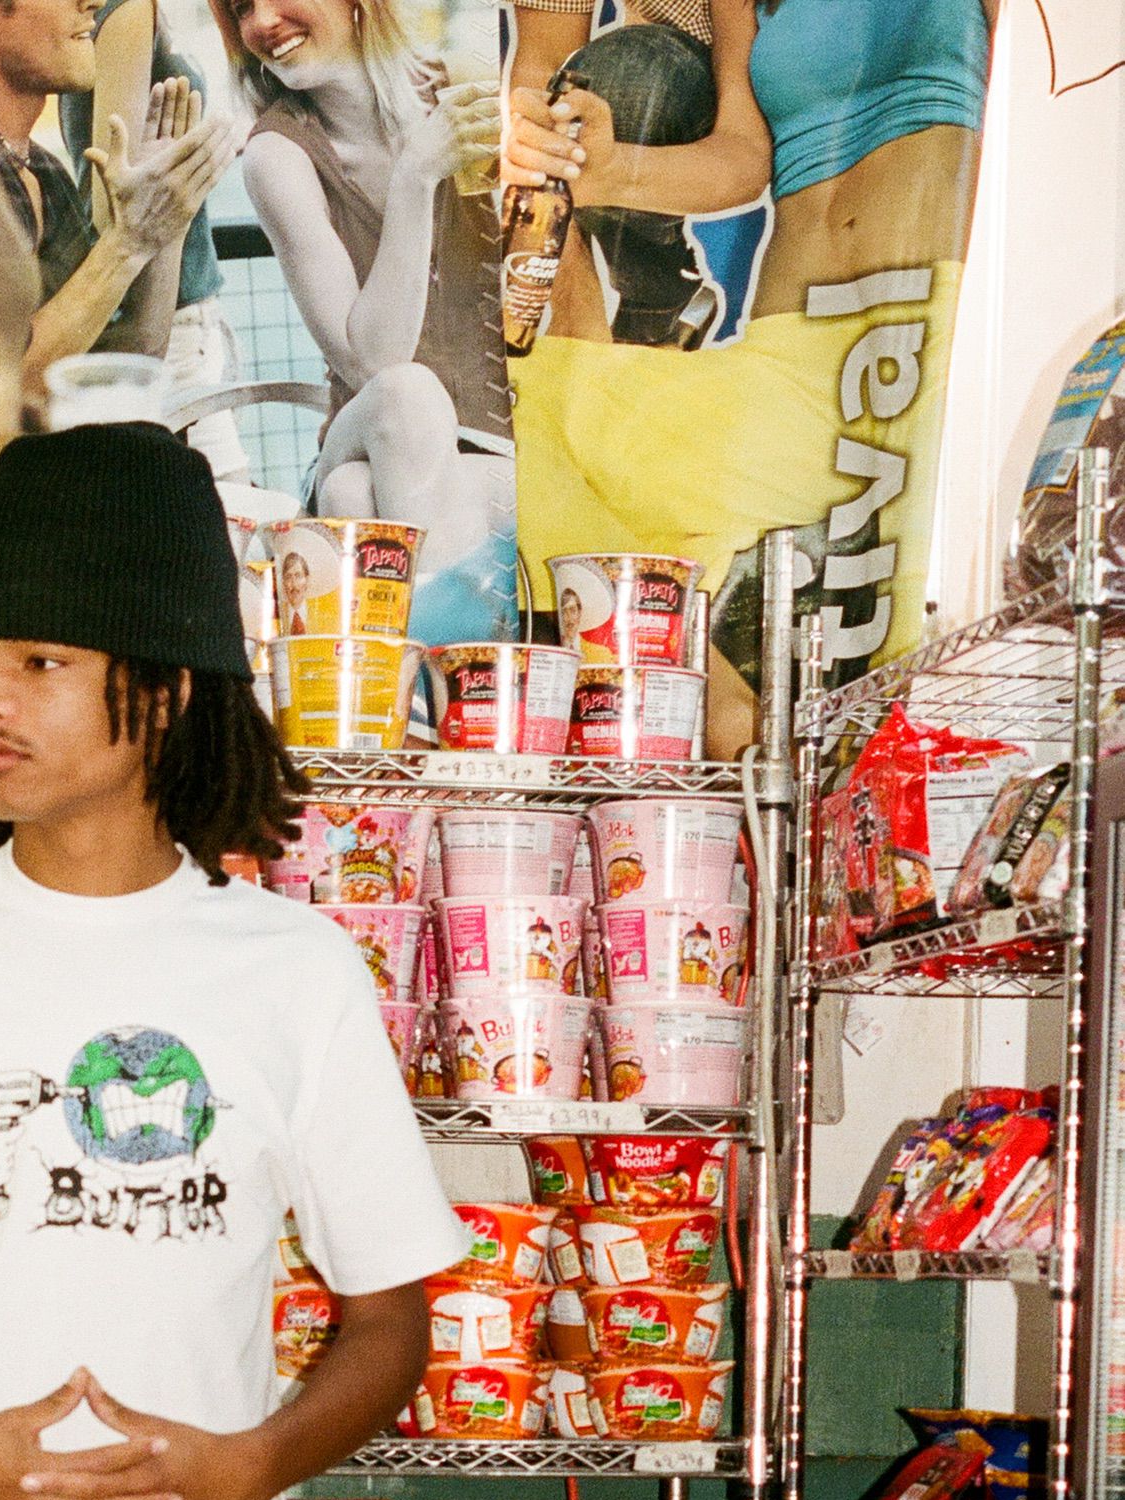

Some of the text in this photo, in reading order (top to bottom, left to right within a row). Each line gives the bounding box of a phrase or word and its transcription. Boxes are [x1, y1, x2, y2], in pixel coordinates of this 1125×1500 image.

[792, 268, 933, 673] tival
[620, 1142, 662, 1157] Bowl
[615, 1154, 662, 1169] Noodle
